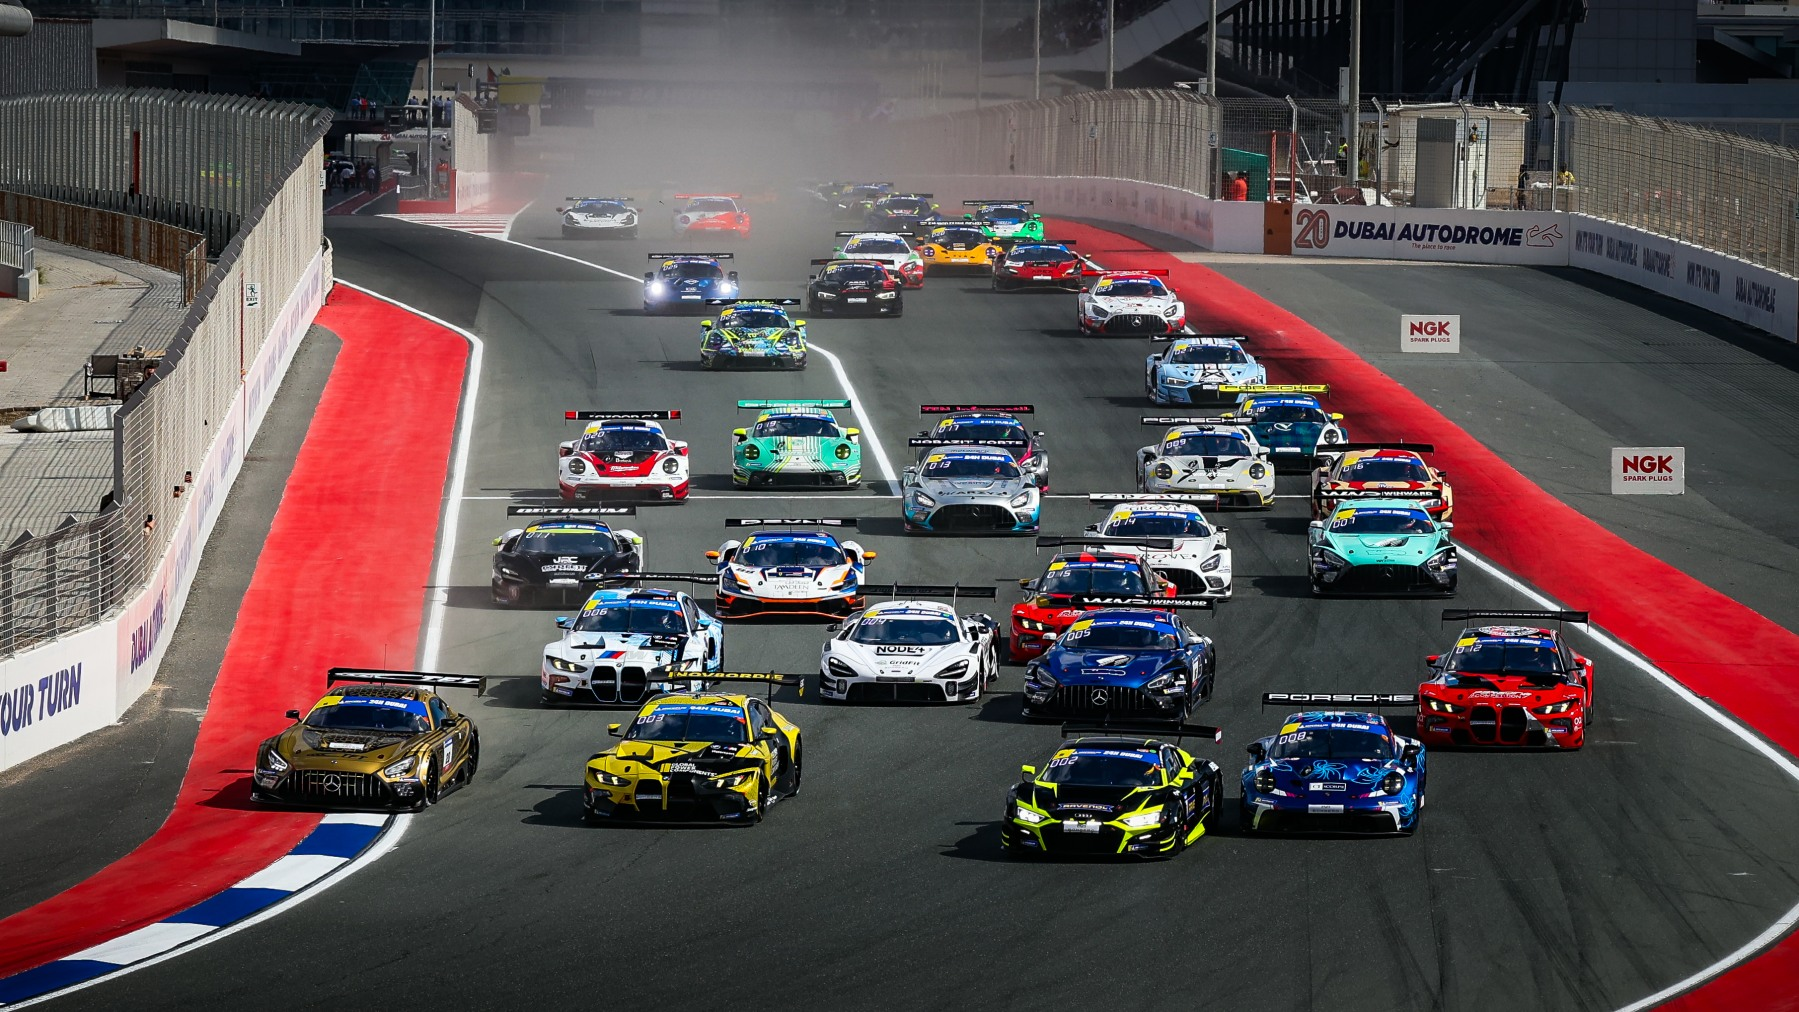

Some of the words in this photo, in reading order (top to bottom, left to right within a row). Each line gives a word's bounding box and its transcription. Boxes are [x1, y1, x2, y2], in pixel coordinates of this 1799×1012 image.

[1295, 209, 1330, 249] 20
[1334, 221, 1396, 240] DUBAI
[1397, 223, 1523, 246] AUTODROME
[1410, 321, 1450, 336] NGK
[1622, 455, 1674, 474] NGK
[583, 608, 608, 617] 006
[1066, 630, 1091, 641] 005
[0, 683, 34, 736] OUR
[38, 662, 82, 721] TURN
[1268, 693, 1414, 701] PORSCHE
[637, 714, 665, 724] 003
[1279, 731, 1307, 744] 008
[1050, 757, 1078, 767] 002
[669, 769, 718, 777] COMPONENTS
